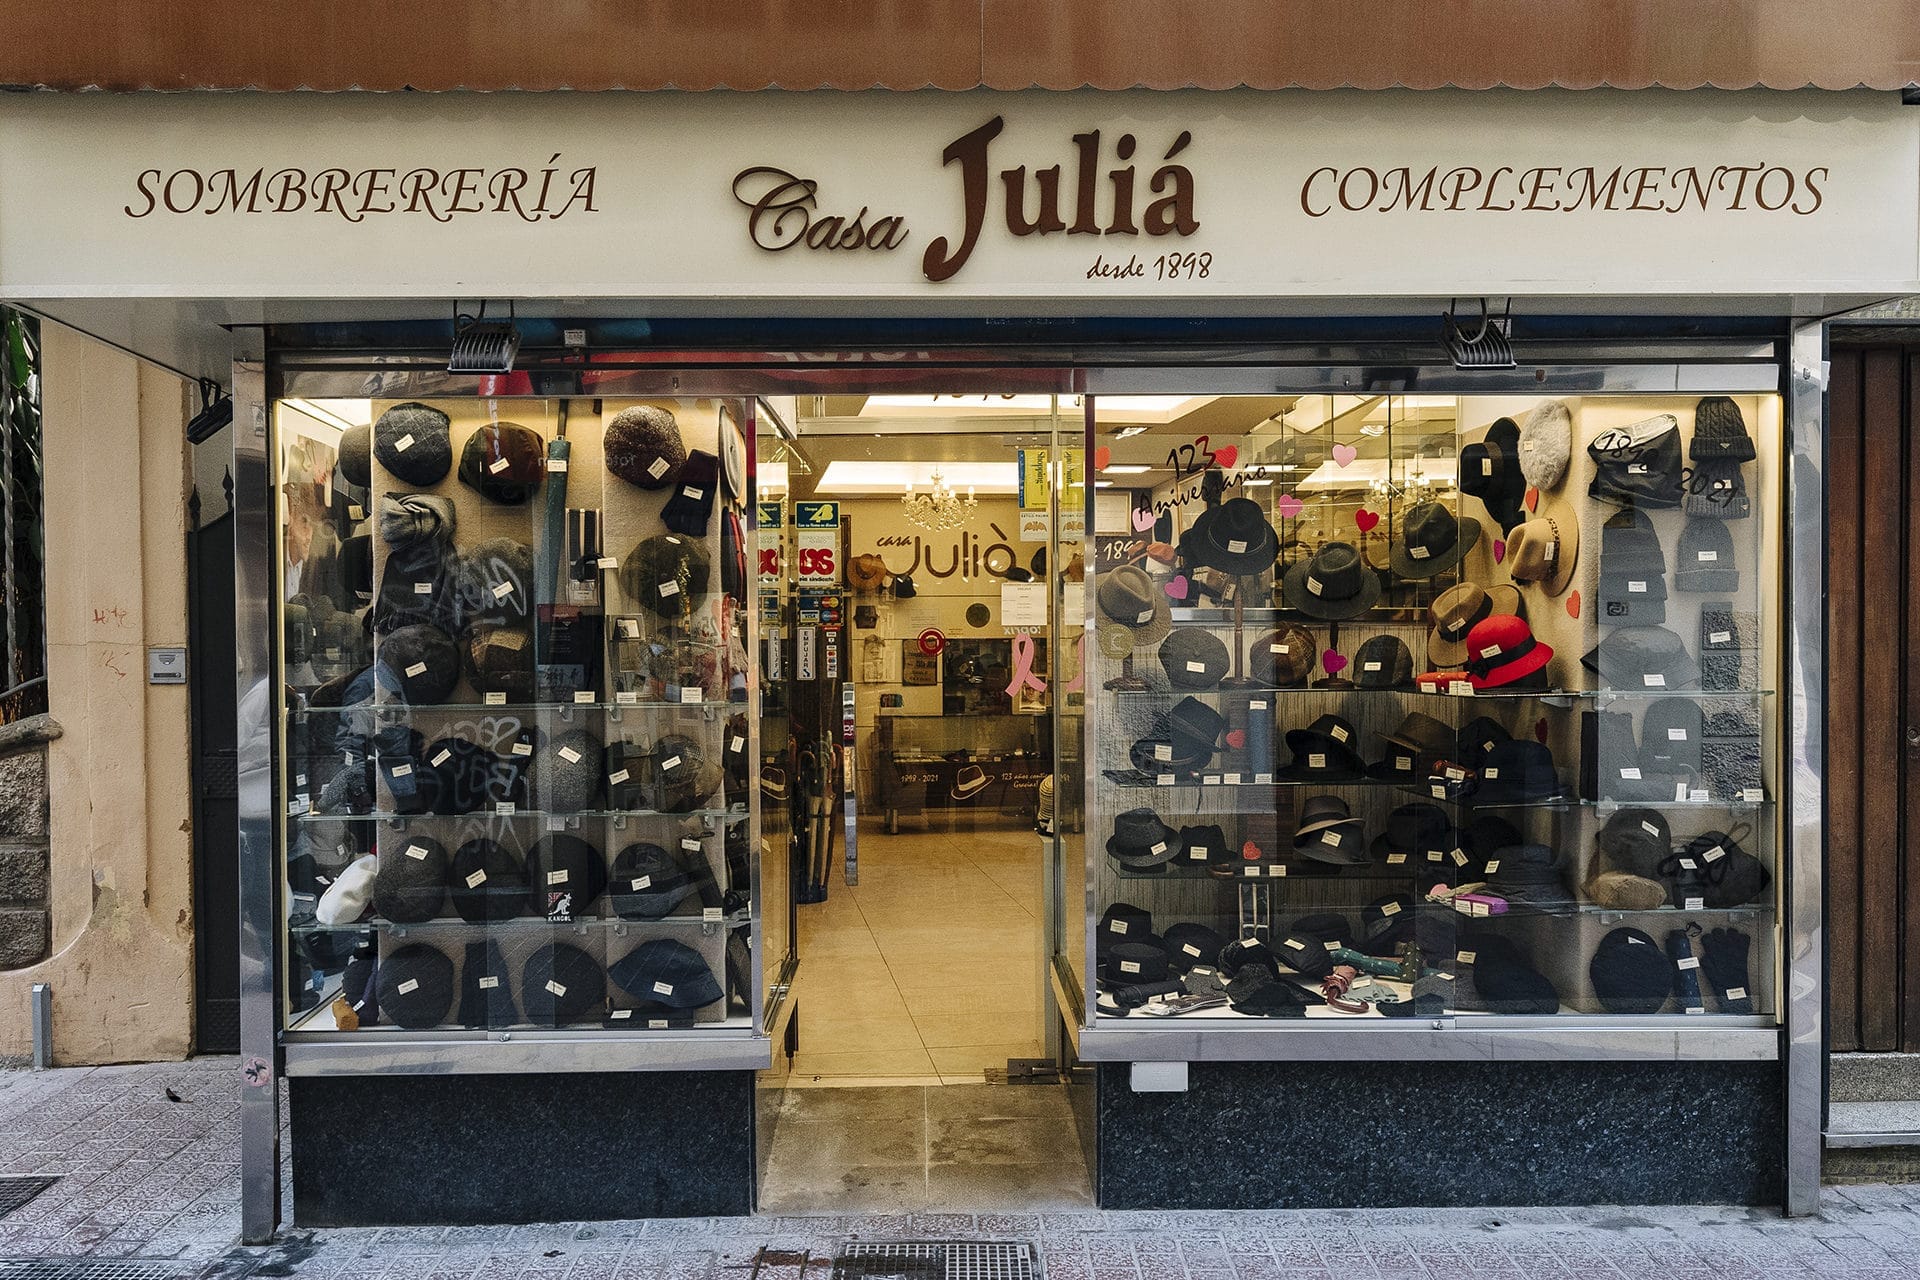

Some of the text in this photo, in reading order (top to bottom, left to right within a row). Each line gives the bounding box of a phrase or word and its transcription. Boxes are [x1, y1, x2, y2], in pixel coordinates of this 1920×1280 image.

[124, 153, 599, 222] SOMBRERERÍA
[733, 116, 1201, 283] Casa Juliá
[1301, 161, 1829, 217] COMPLEMENTOS
[1087, 252, 1213, 281] desde 1898
[1031, 452, 1046, 484] Shopping
[1166, 435, 1217, 480] 123
[876, 535, 913, 547] casa
[1103, 540, 1141, 561] 189
[922, 774, 938, 783] 2021
[1001, 772, 1013, 780] 123
